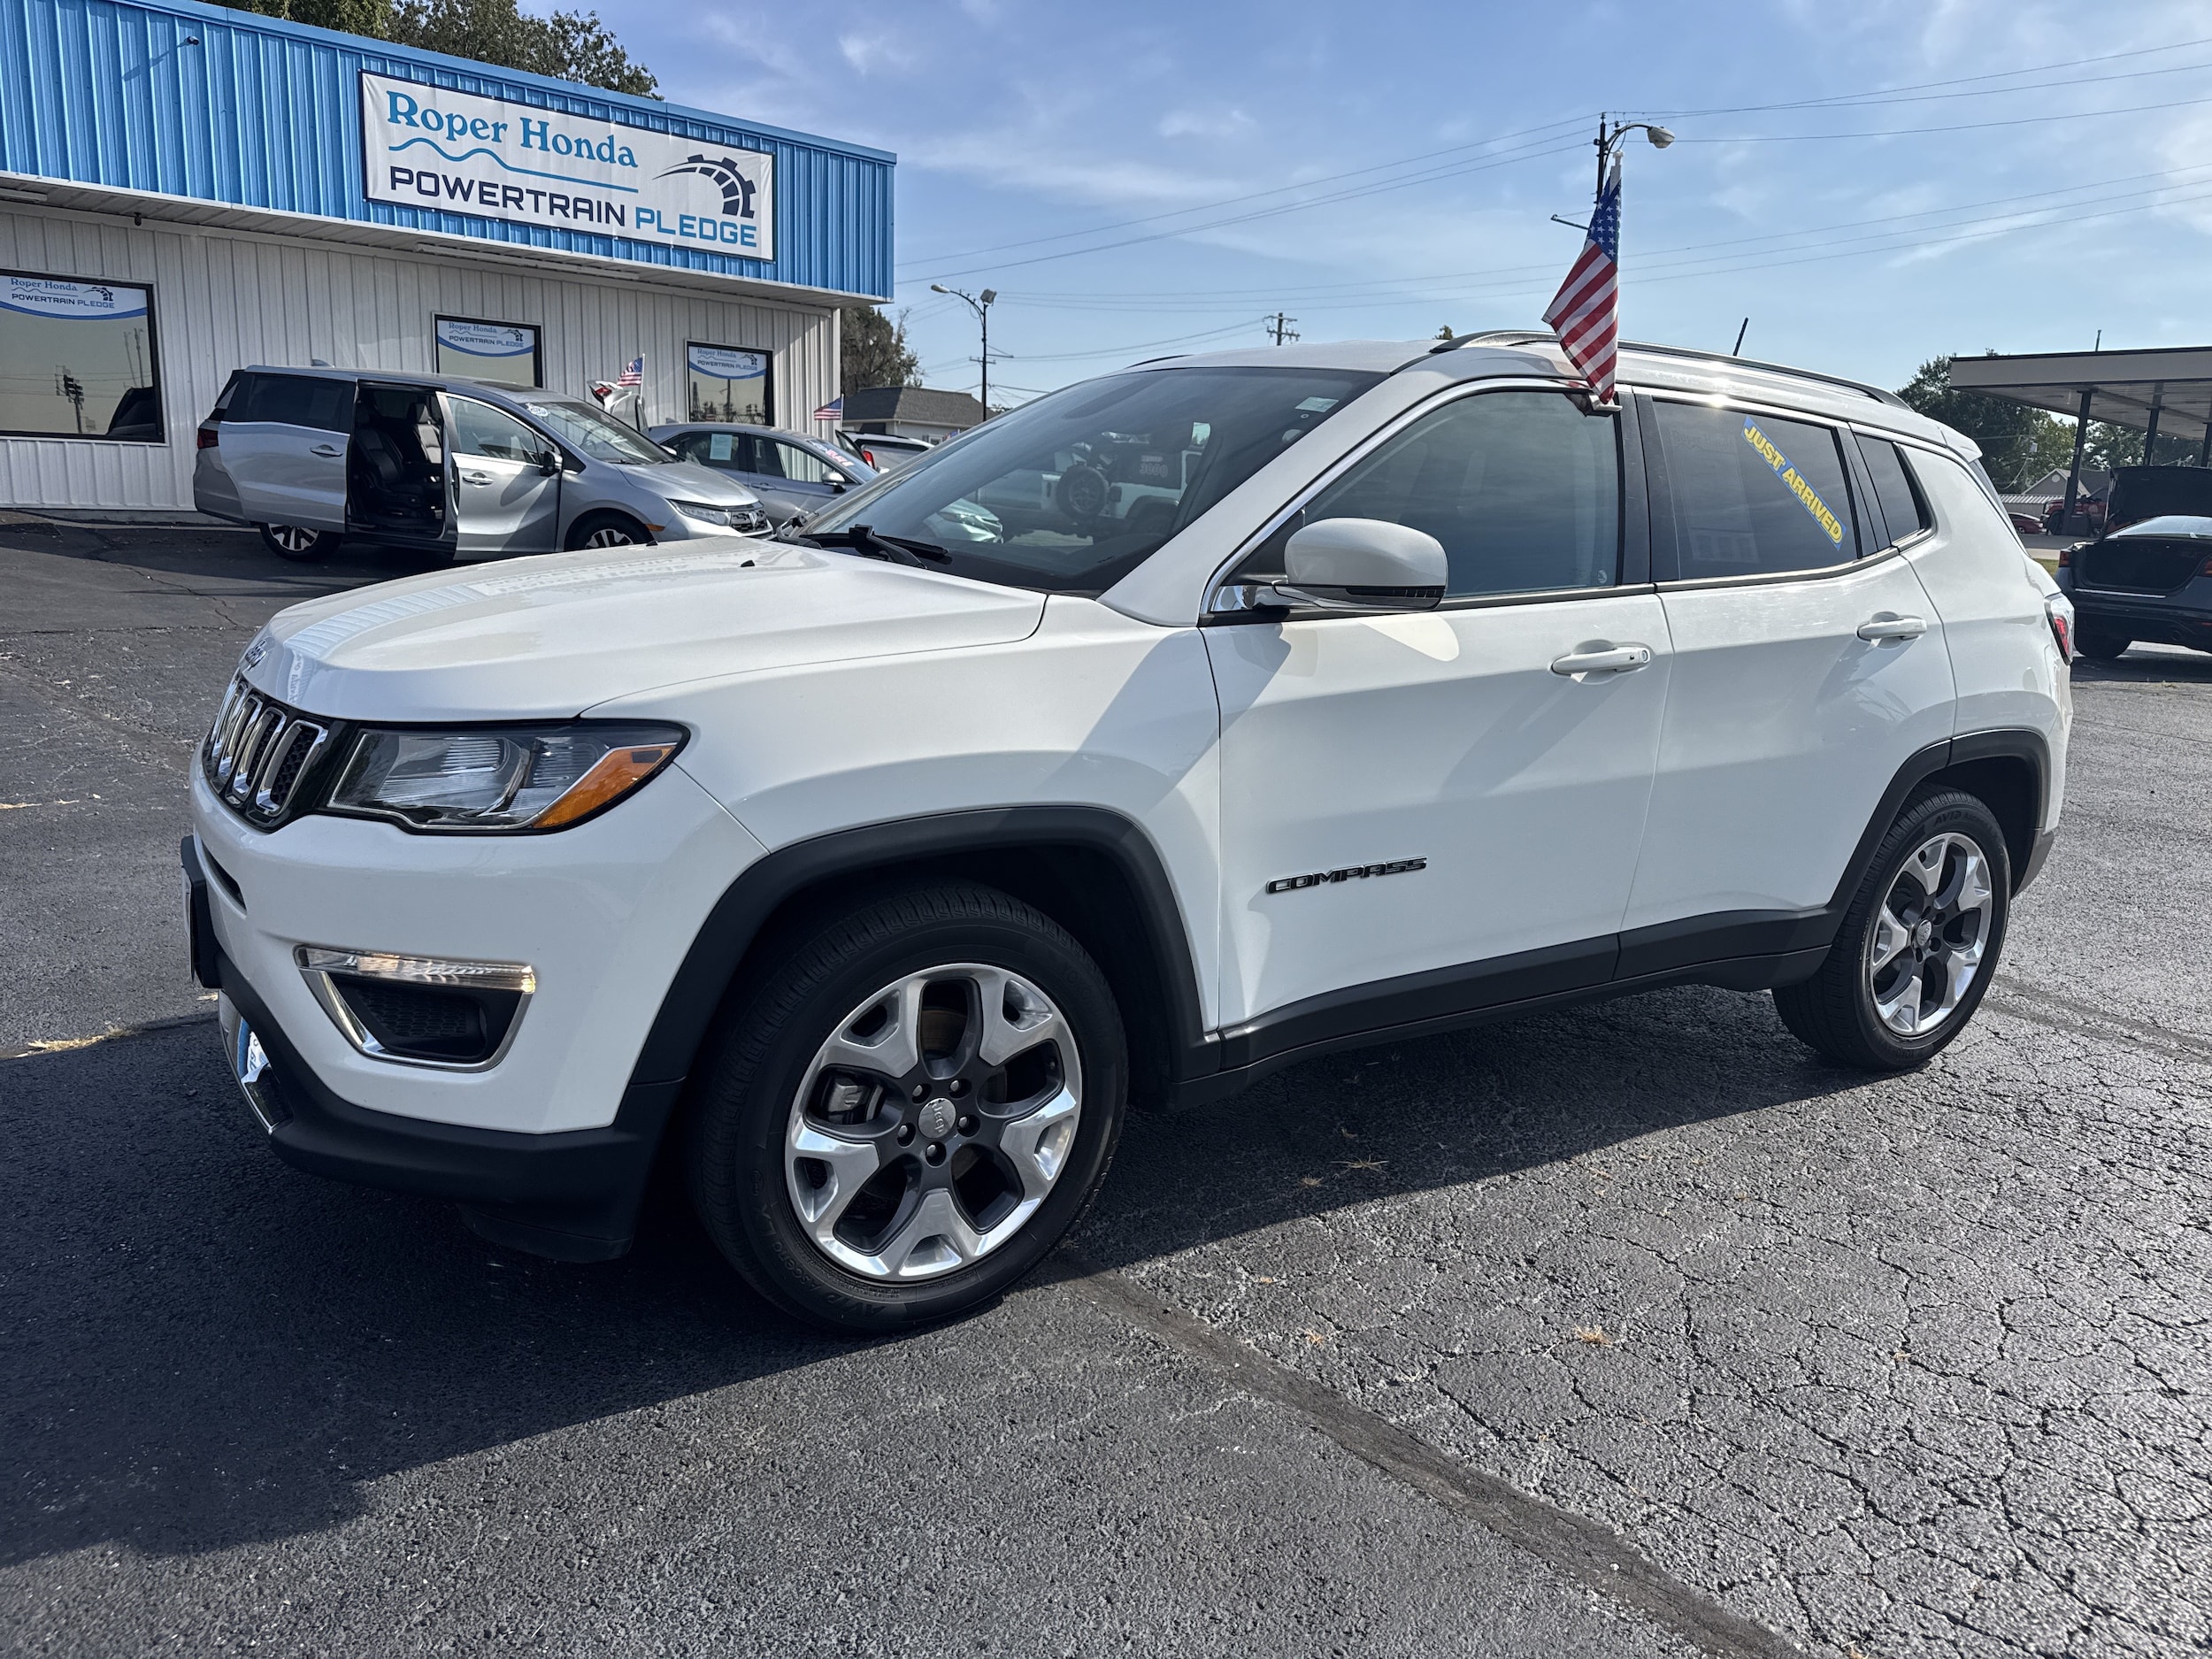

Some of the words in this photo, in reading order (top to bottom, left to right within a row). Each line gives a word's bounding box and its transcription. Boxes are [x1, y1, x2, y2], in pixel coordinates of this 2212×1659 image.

[387, 90, 508, 143] Roper
[520, 117, 639, 168] Honda
[390, 165, 626, 227] POWERTRAIN
[635, 207, 757, 248] PLEDGE
[11, 277, 42, 289] Roper
[44, 280, 78, 292] Honda
[12, 293, 75, 305] POWERTRAIN
[77, 299, 115, 309] PLEDGE
[449, 322, 472, 331] Roper
[473, 324, 497, 334] Honda
[449, 335, 495, 345] POWERTRAIN
[1744, 426, 1786, 472] JUST
[1782, 467, 1843, 544] ARRIVED
[1265, 855, 1428, 895] COMPASS
[931, 1102, 945, 1133] Jeep
